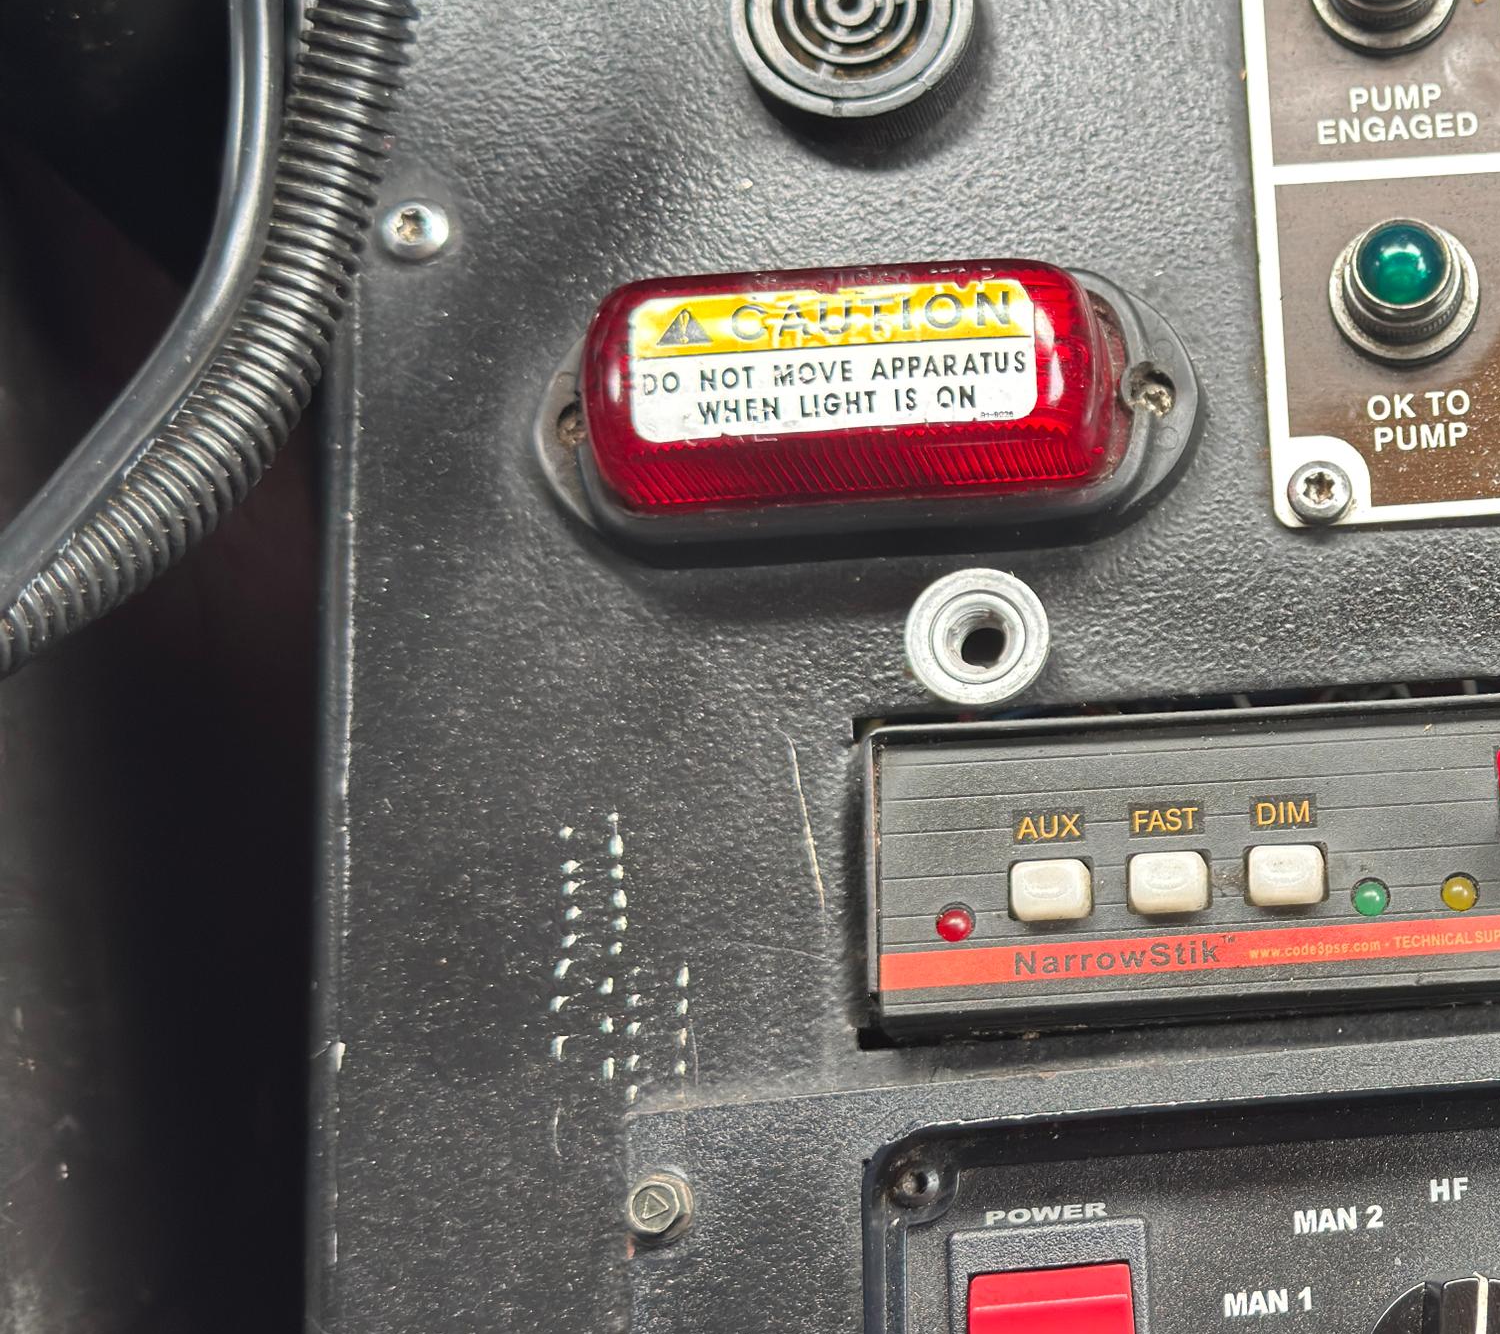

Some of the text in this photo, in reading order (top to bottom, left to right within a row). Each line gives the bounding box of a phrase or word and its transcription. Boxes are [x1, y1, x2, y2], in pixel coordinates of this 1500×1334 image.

[1350, 83, 1442, 113] PUMP
[1316, 111, 1478, 145] ENGAGED
[731, 290, 1012, 342] CAUTION
[641, 350, 1027, 397] DO NOT MOVE APPARATUS
[697, 384, 978, 425] WHEN LIGHT IS ON
[1366, 389, 1470, 421] OK TO
[1374, 421, 1469, 452] PUMP
[1016, 799, 1312, 841] AUX FAST DIM
[1249, 939, 1382, 961] www.code3pse.com
[1393, 930, 1472, 949] TECHNICAL
[1430, 1177, 1469, 1202] HF
[985, 1201, 1108, 1227] POWER
[1293, 1205, 1385, 1236] MAN 2
[1224, 1286, 1314, 1317] MAN 1
